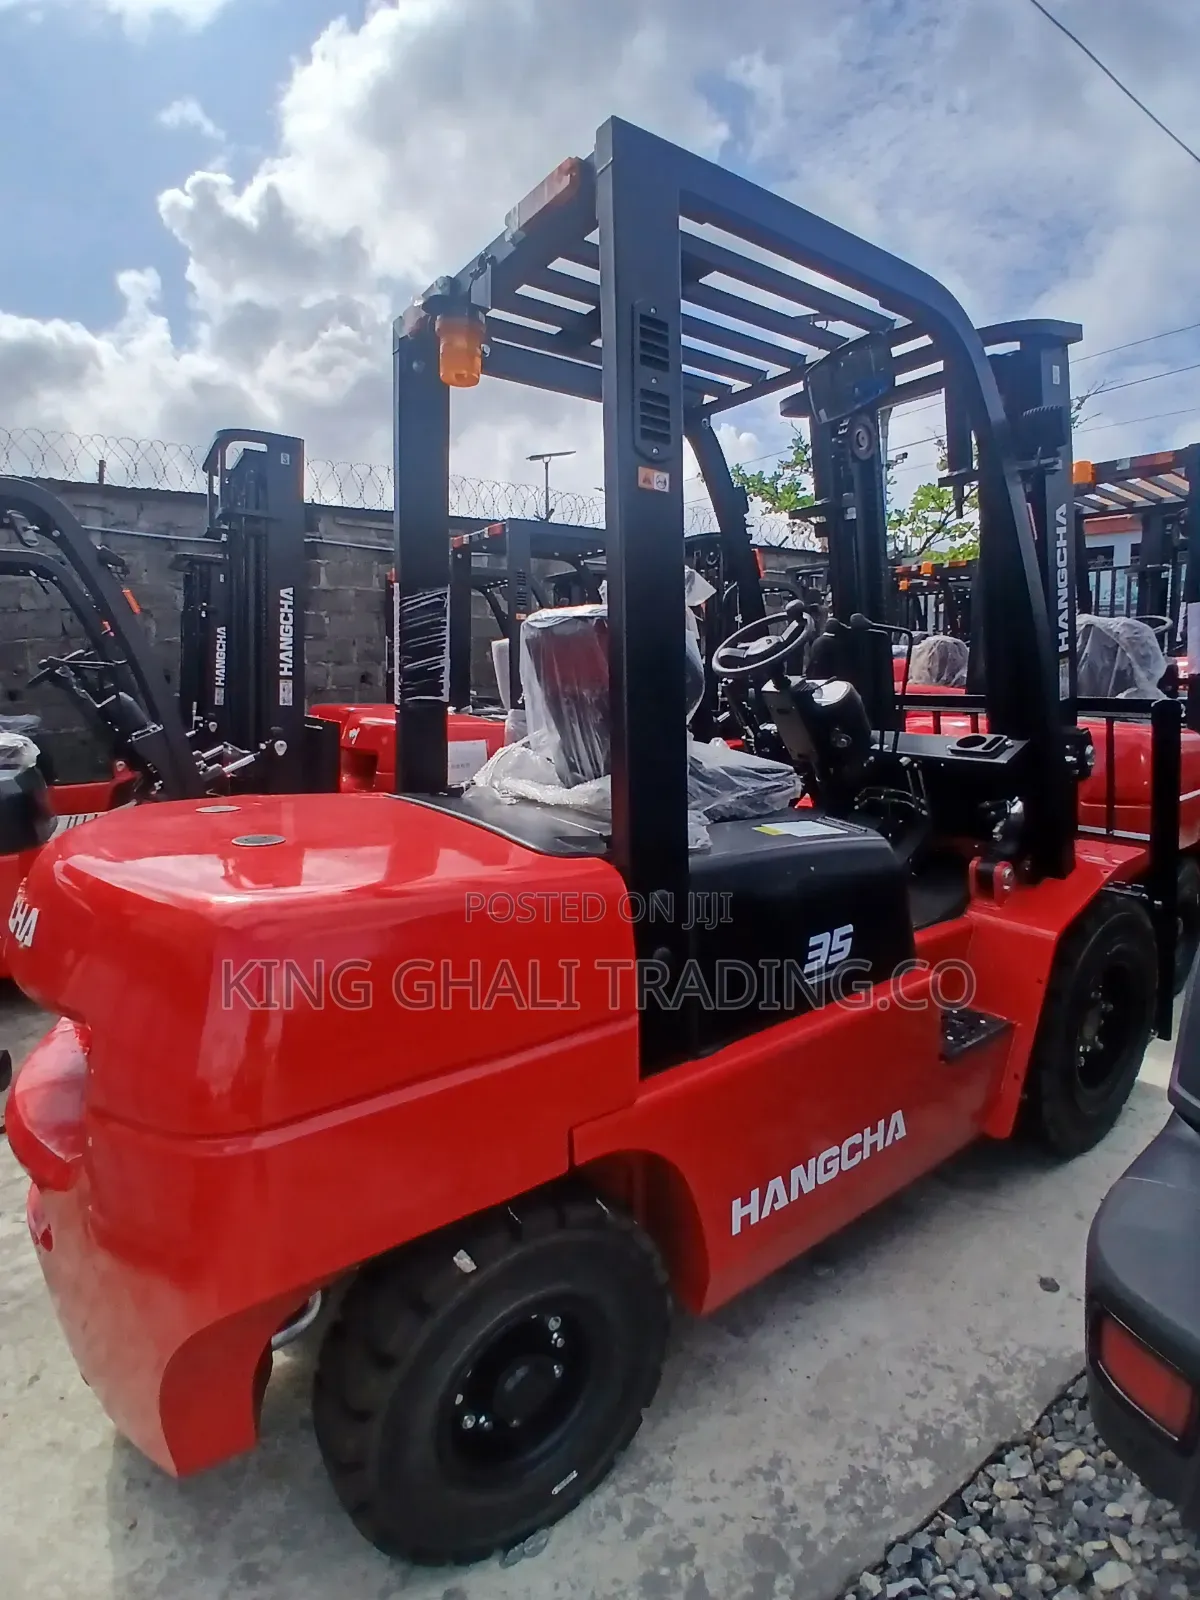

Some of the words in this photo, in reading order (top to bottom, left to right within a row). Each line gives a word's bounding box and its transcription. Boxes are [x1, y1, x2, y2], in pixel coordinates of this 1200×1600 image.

[1056, 503, 1069, 652] HANGCHA
[215, 626, 226, 686] HANGCHA
[279, 587, 294, 676] HANGCHA
[803, 924, 854, 974] 35
[731, 1109, 907, 1236] HANGCHA
